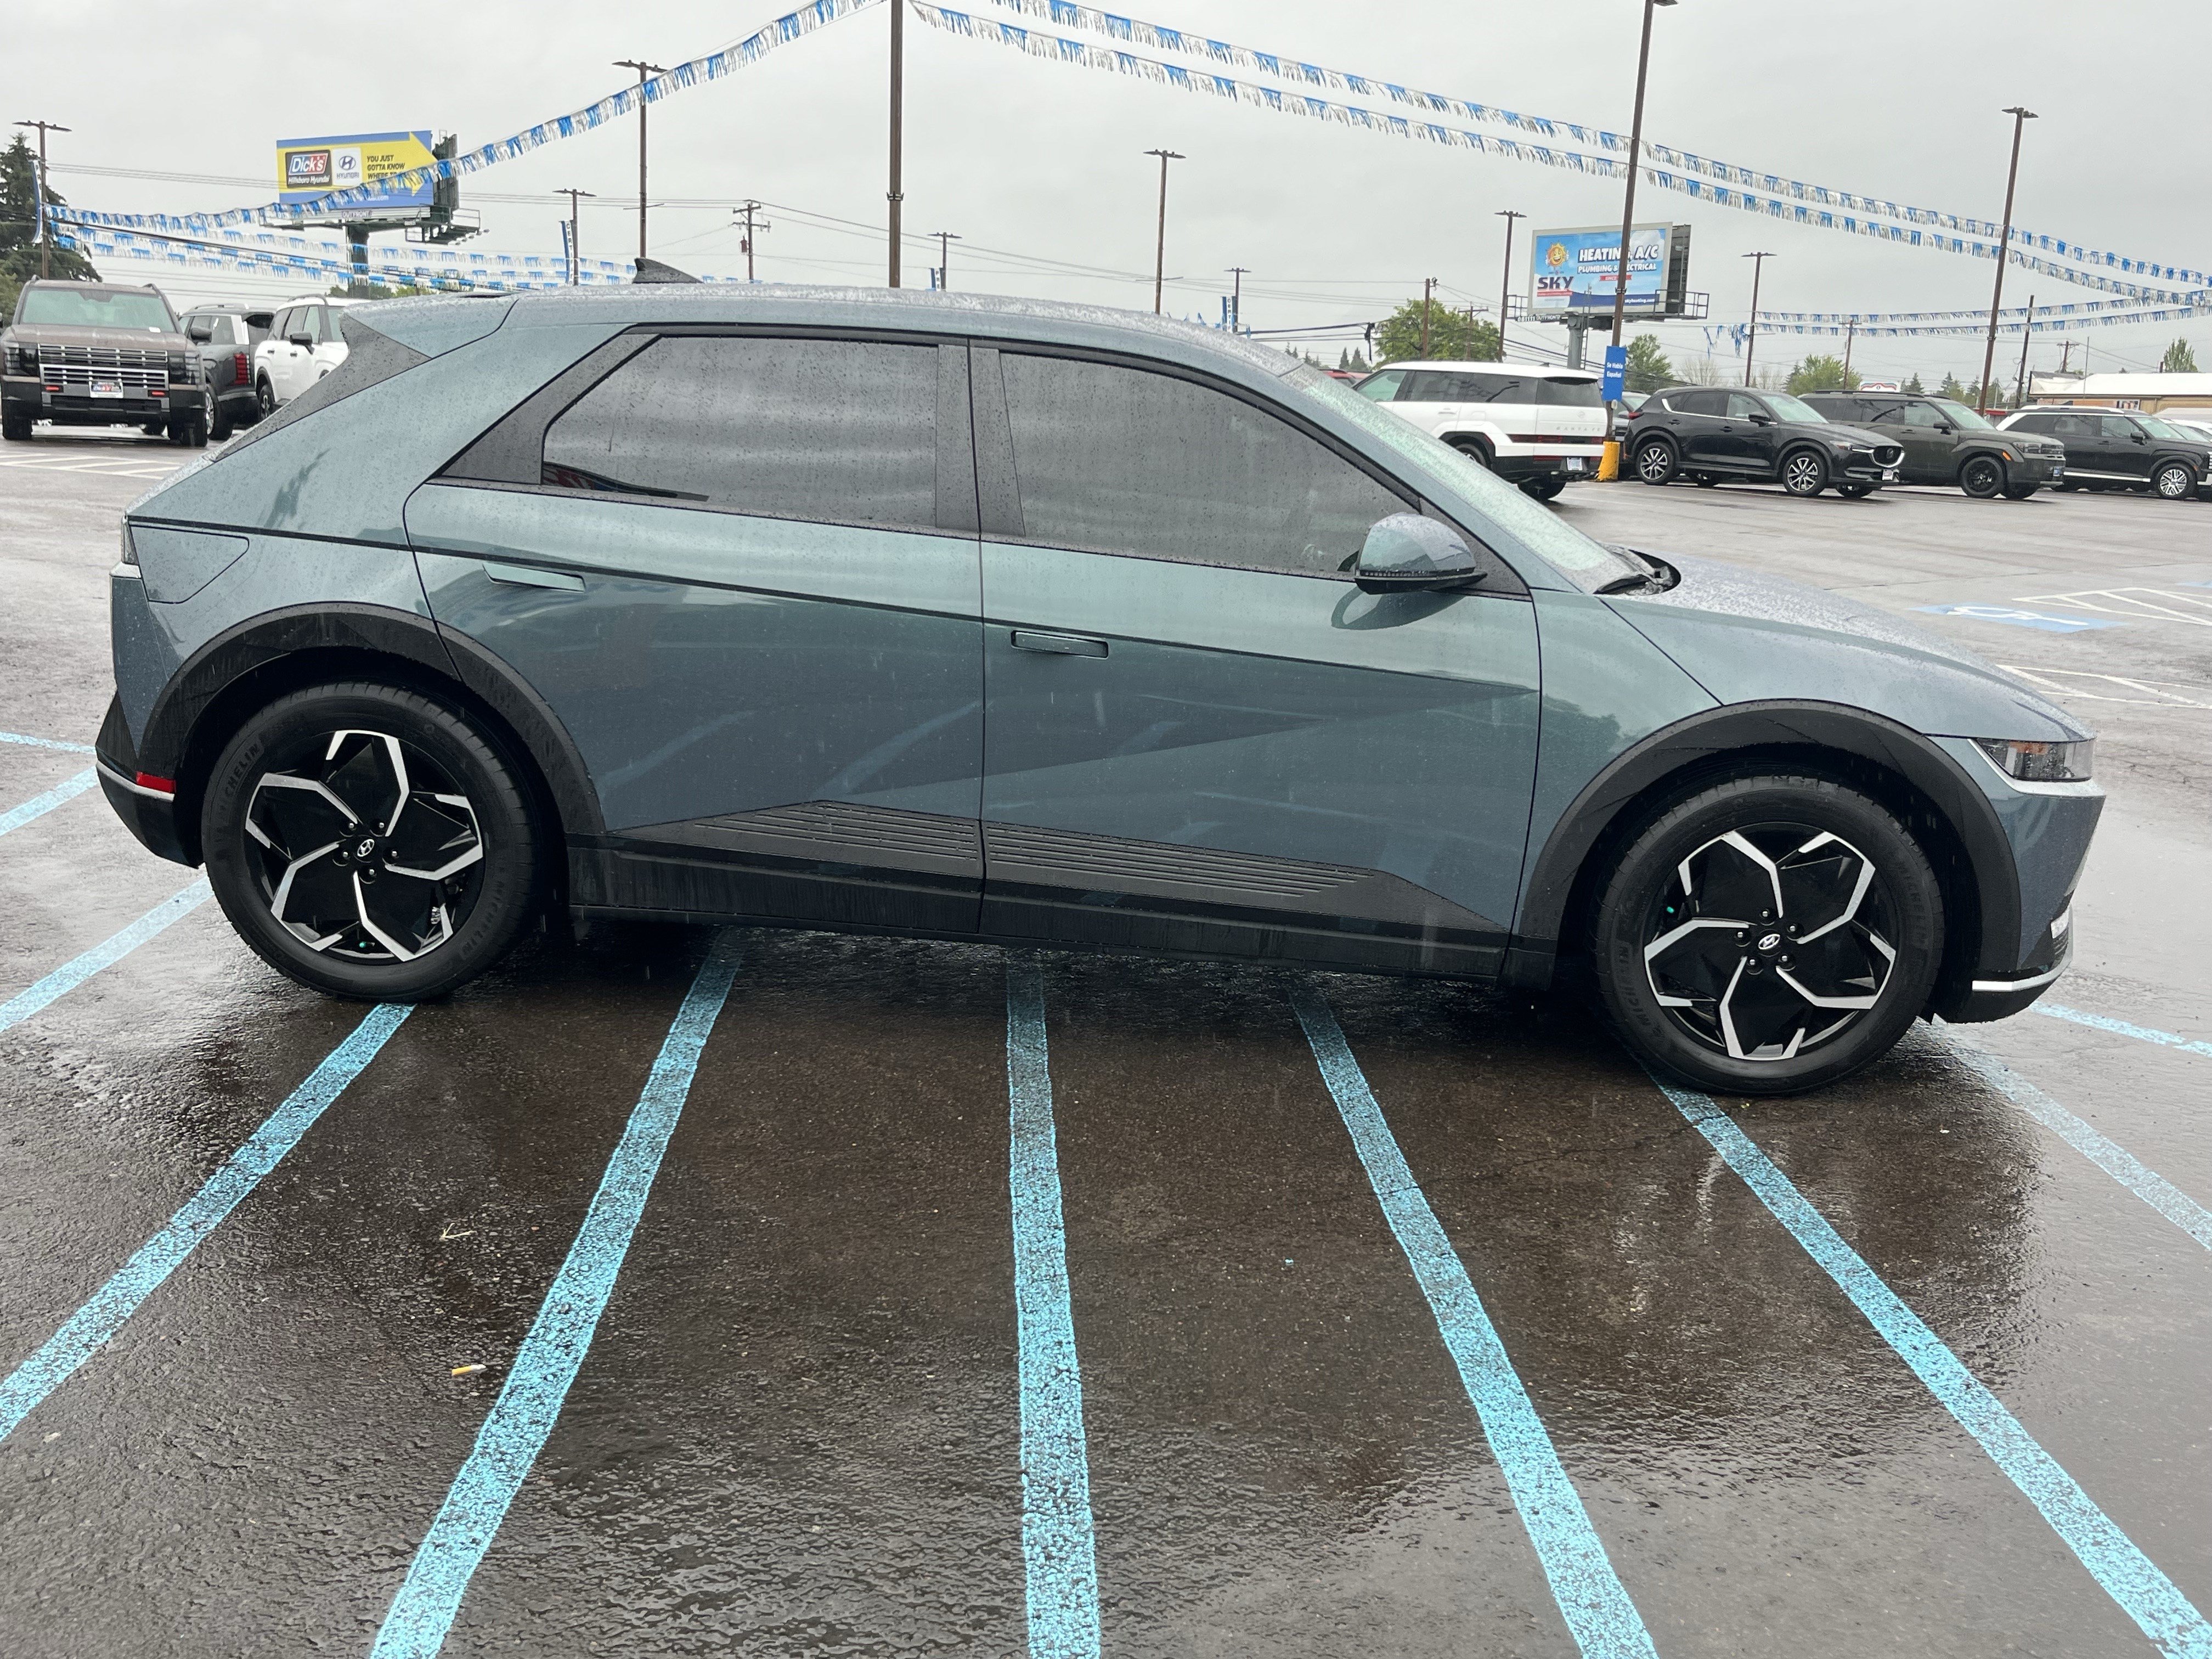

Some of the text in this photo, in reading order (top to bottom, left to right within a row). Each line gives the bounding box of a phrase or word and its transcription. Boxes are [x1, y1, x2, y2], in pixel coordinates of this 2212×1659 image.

[1634, 245, 1659, 261] A/C
[1577, 264, 1612, 274] PLUMBING
[1537, 276, 1574, 290] SKY
